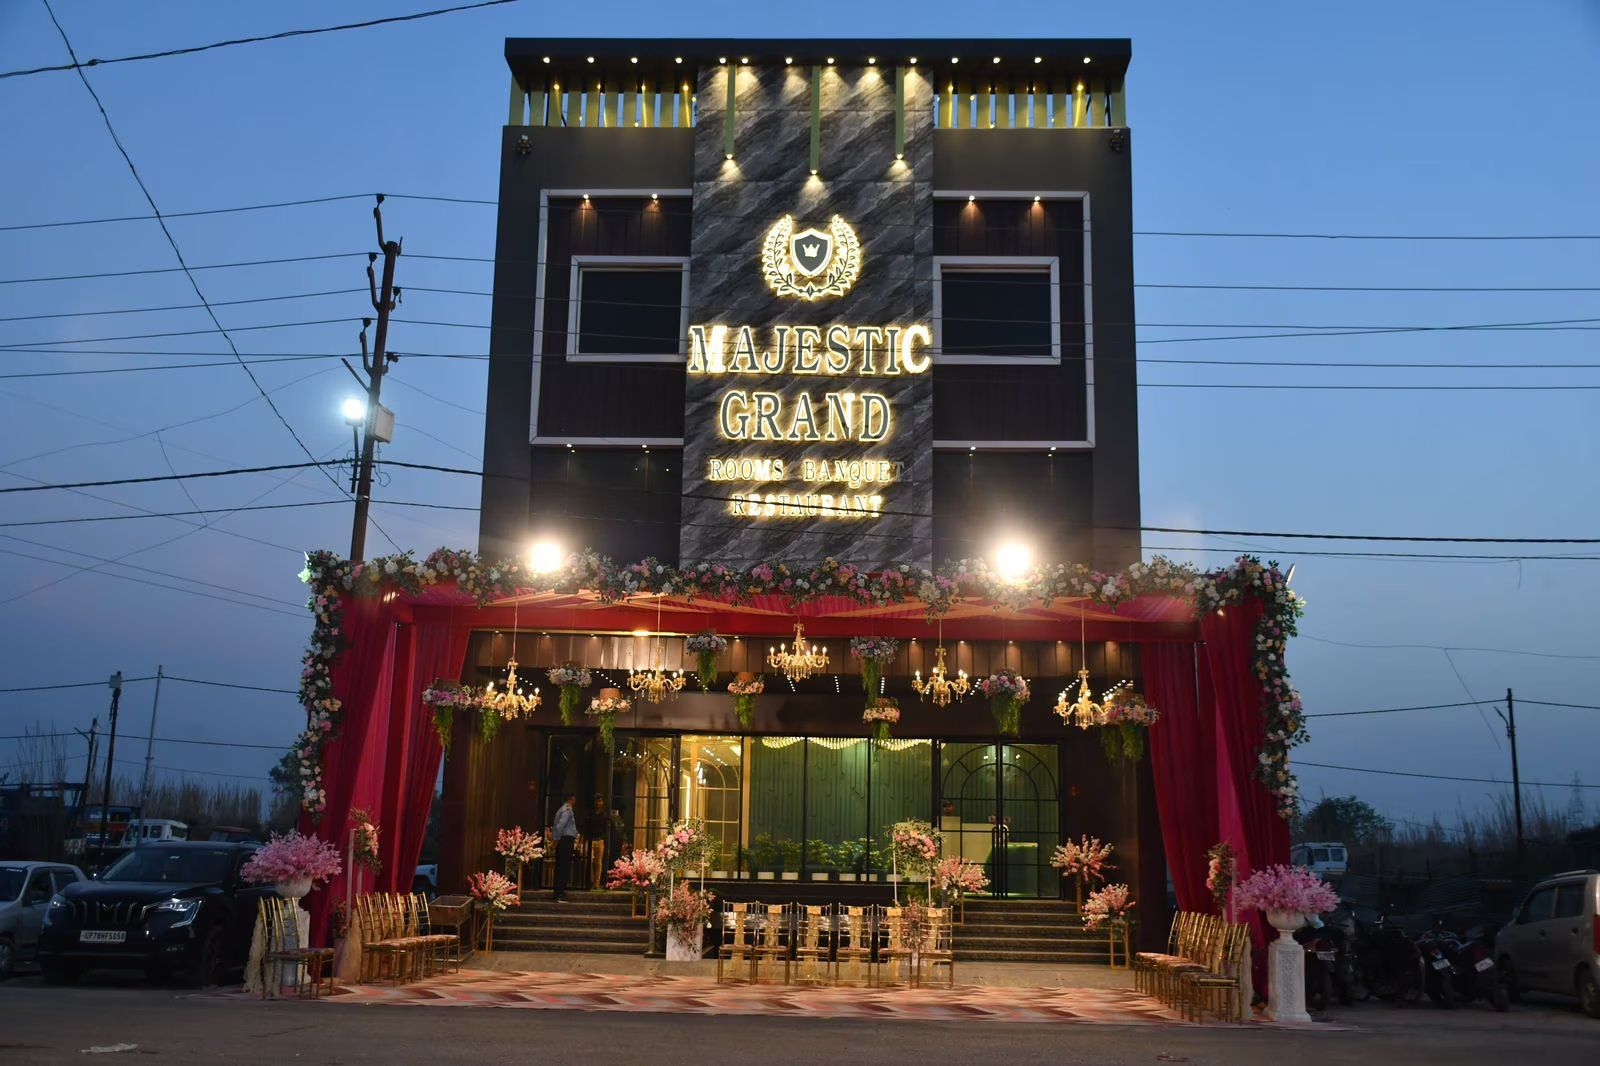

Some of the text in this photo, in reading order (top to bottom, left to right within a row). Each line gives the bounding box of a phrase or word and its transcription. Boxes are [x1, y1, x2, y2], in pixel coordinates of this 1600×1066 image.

[688, 325, 932, 374] MAJESTIC
[720, 391, 890, 441] GRAND
[709, 459, 905, 487] ROOMS BANQUET
[732, 495, 883, 517] RESTAURANT
